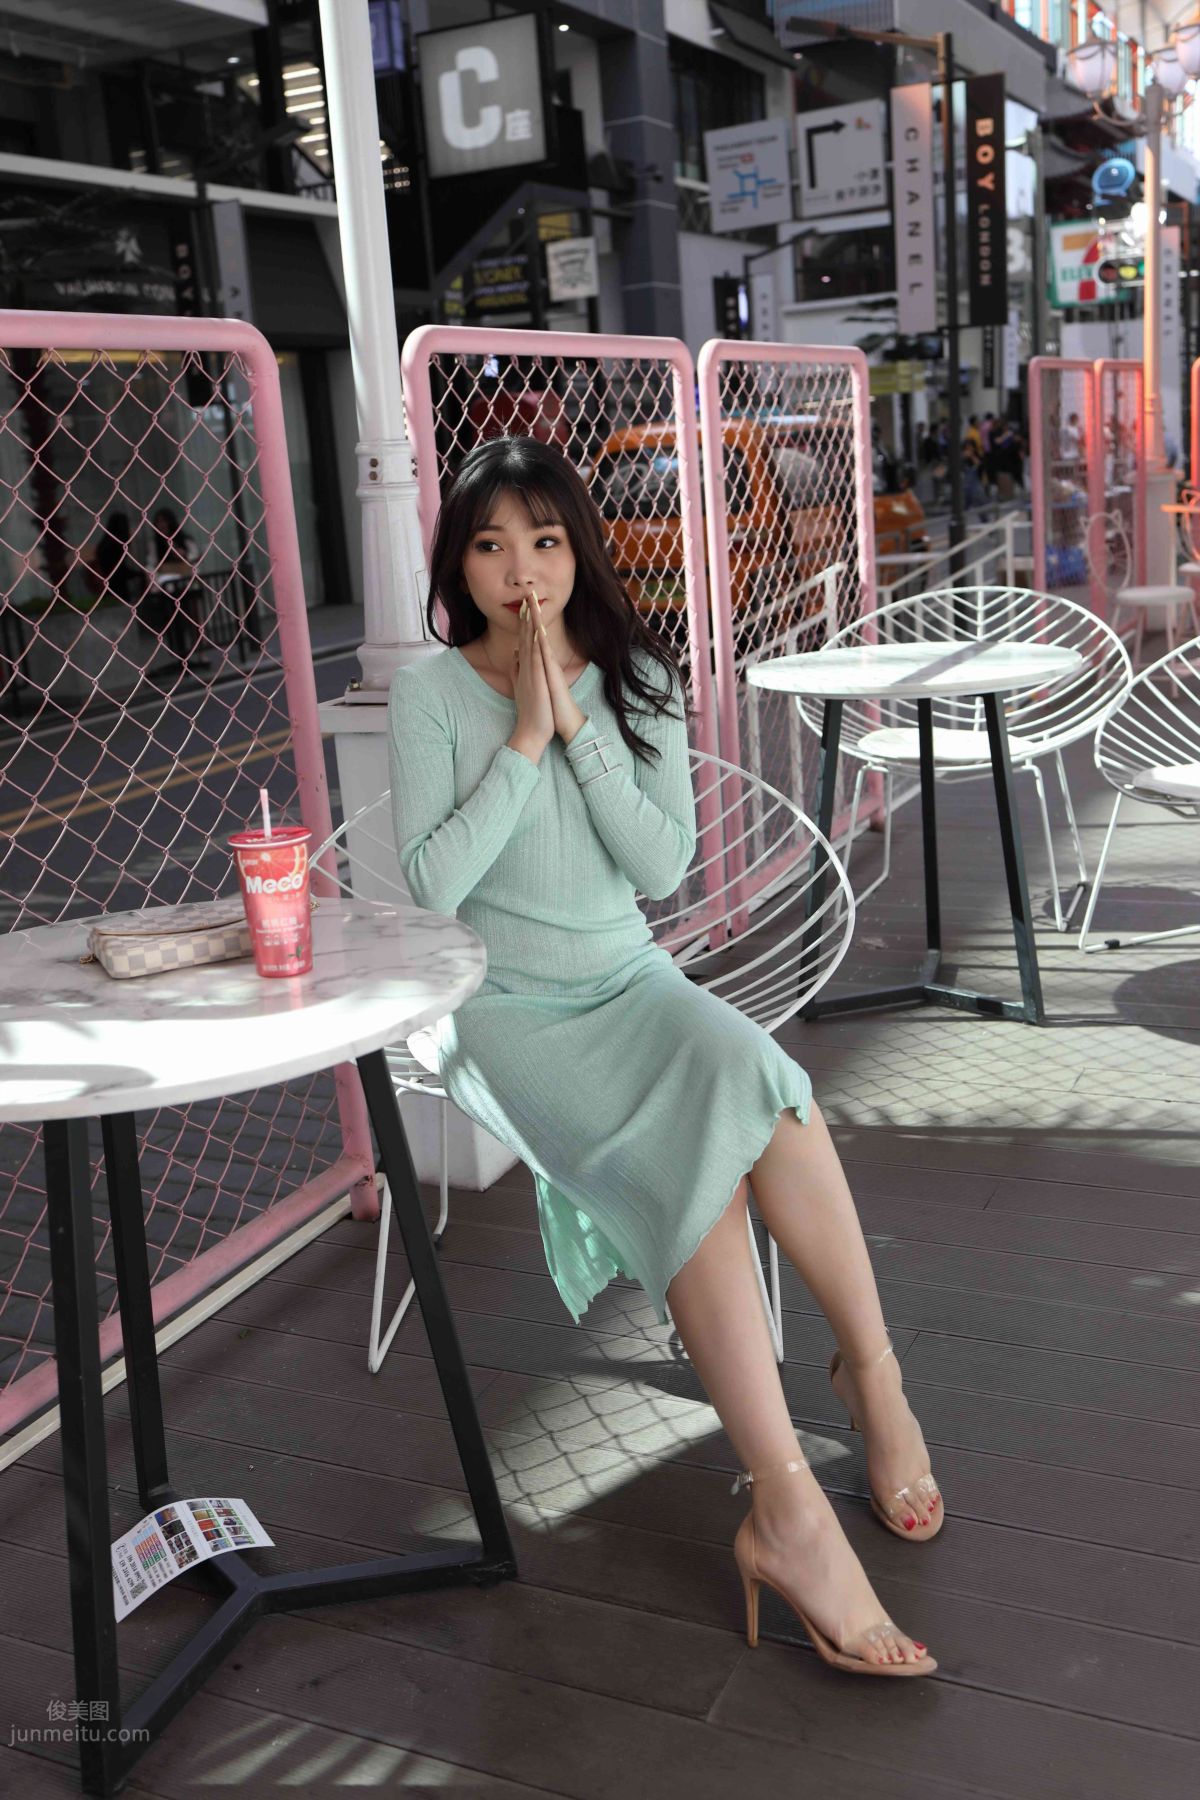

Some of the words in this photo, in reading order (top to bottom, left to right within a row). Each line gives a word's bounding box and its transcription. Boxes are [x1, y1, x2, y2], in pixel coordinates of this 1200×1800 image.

[976, 117, 995, 192] BOY
[905, 127, 923, 296] CHANEL
[978, 204, 991, 288] LONDON
[245, 874, 304, 895] Meco
